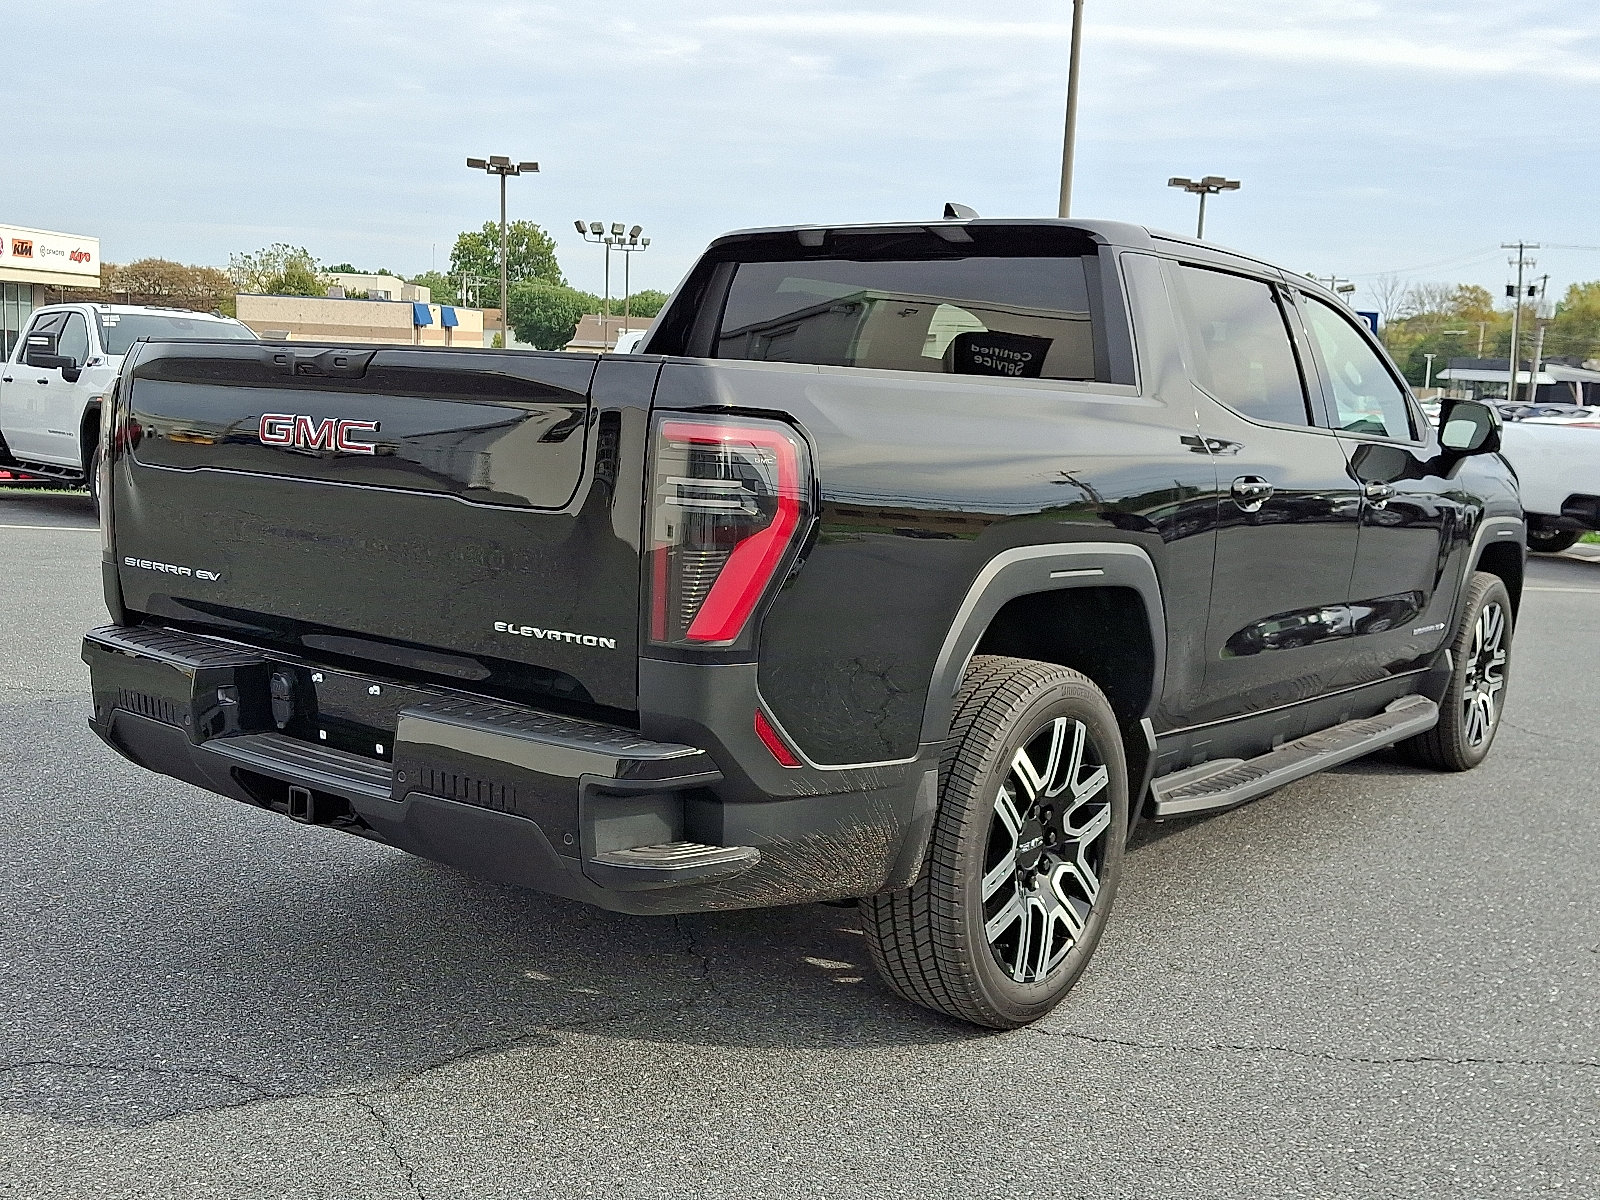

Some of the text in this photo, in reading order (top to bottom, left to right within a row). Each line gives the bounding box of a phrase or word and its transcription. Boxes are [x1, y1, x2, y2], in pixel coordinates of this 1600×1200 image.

[13, 241, 32, 256] KTM
[259, 413, 380, 455] GMC
[124, 556, 221, 581] SIERRA EV
[494, 621, 617, 649] ELEVATION
